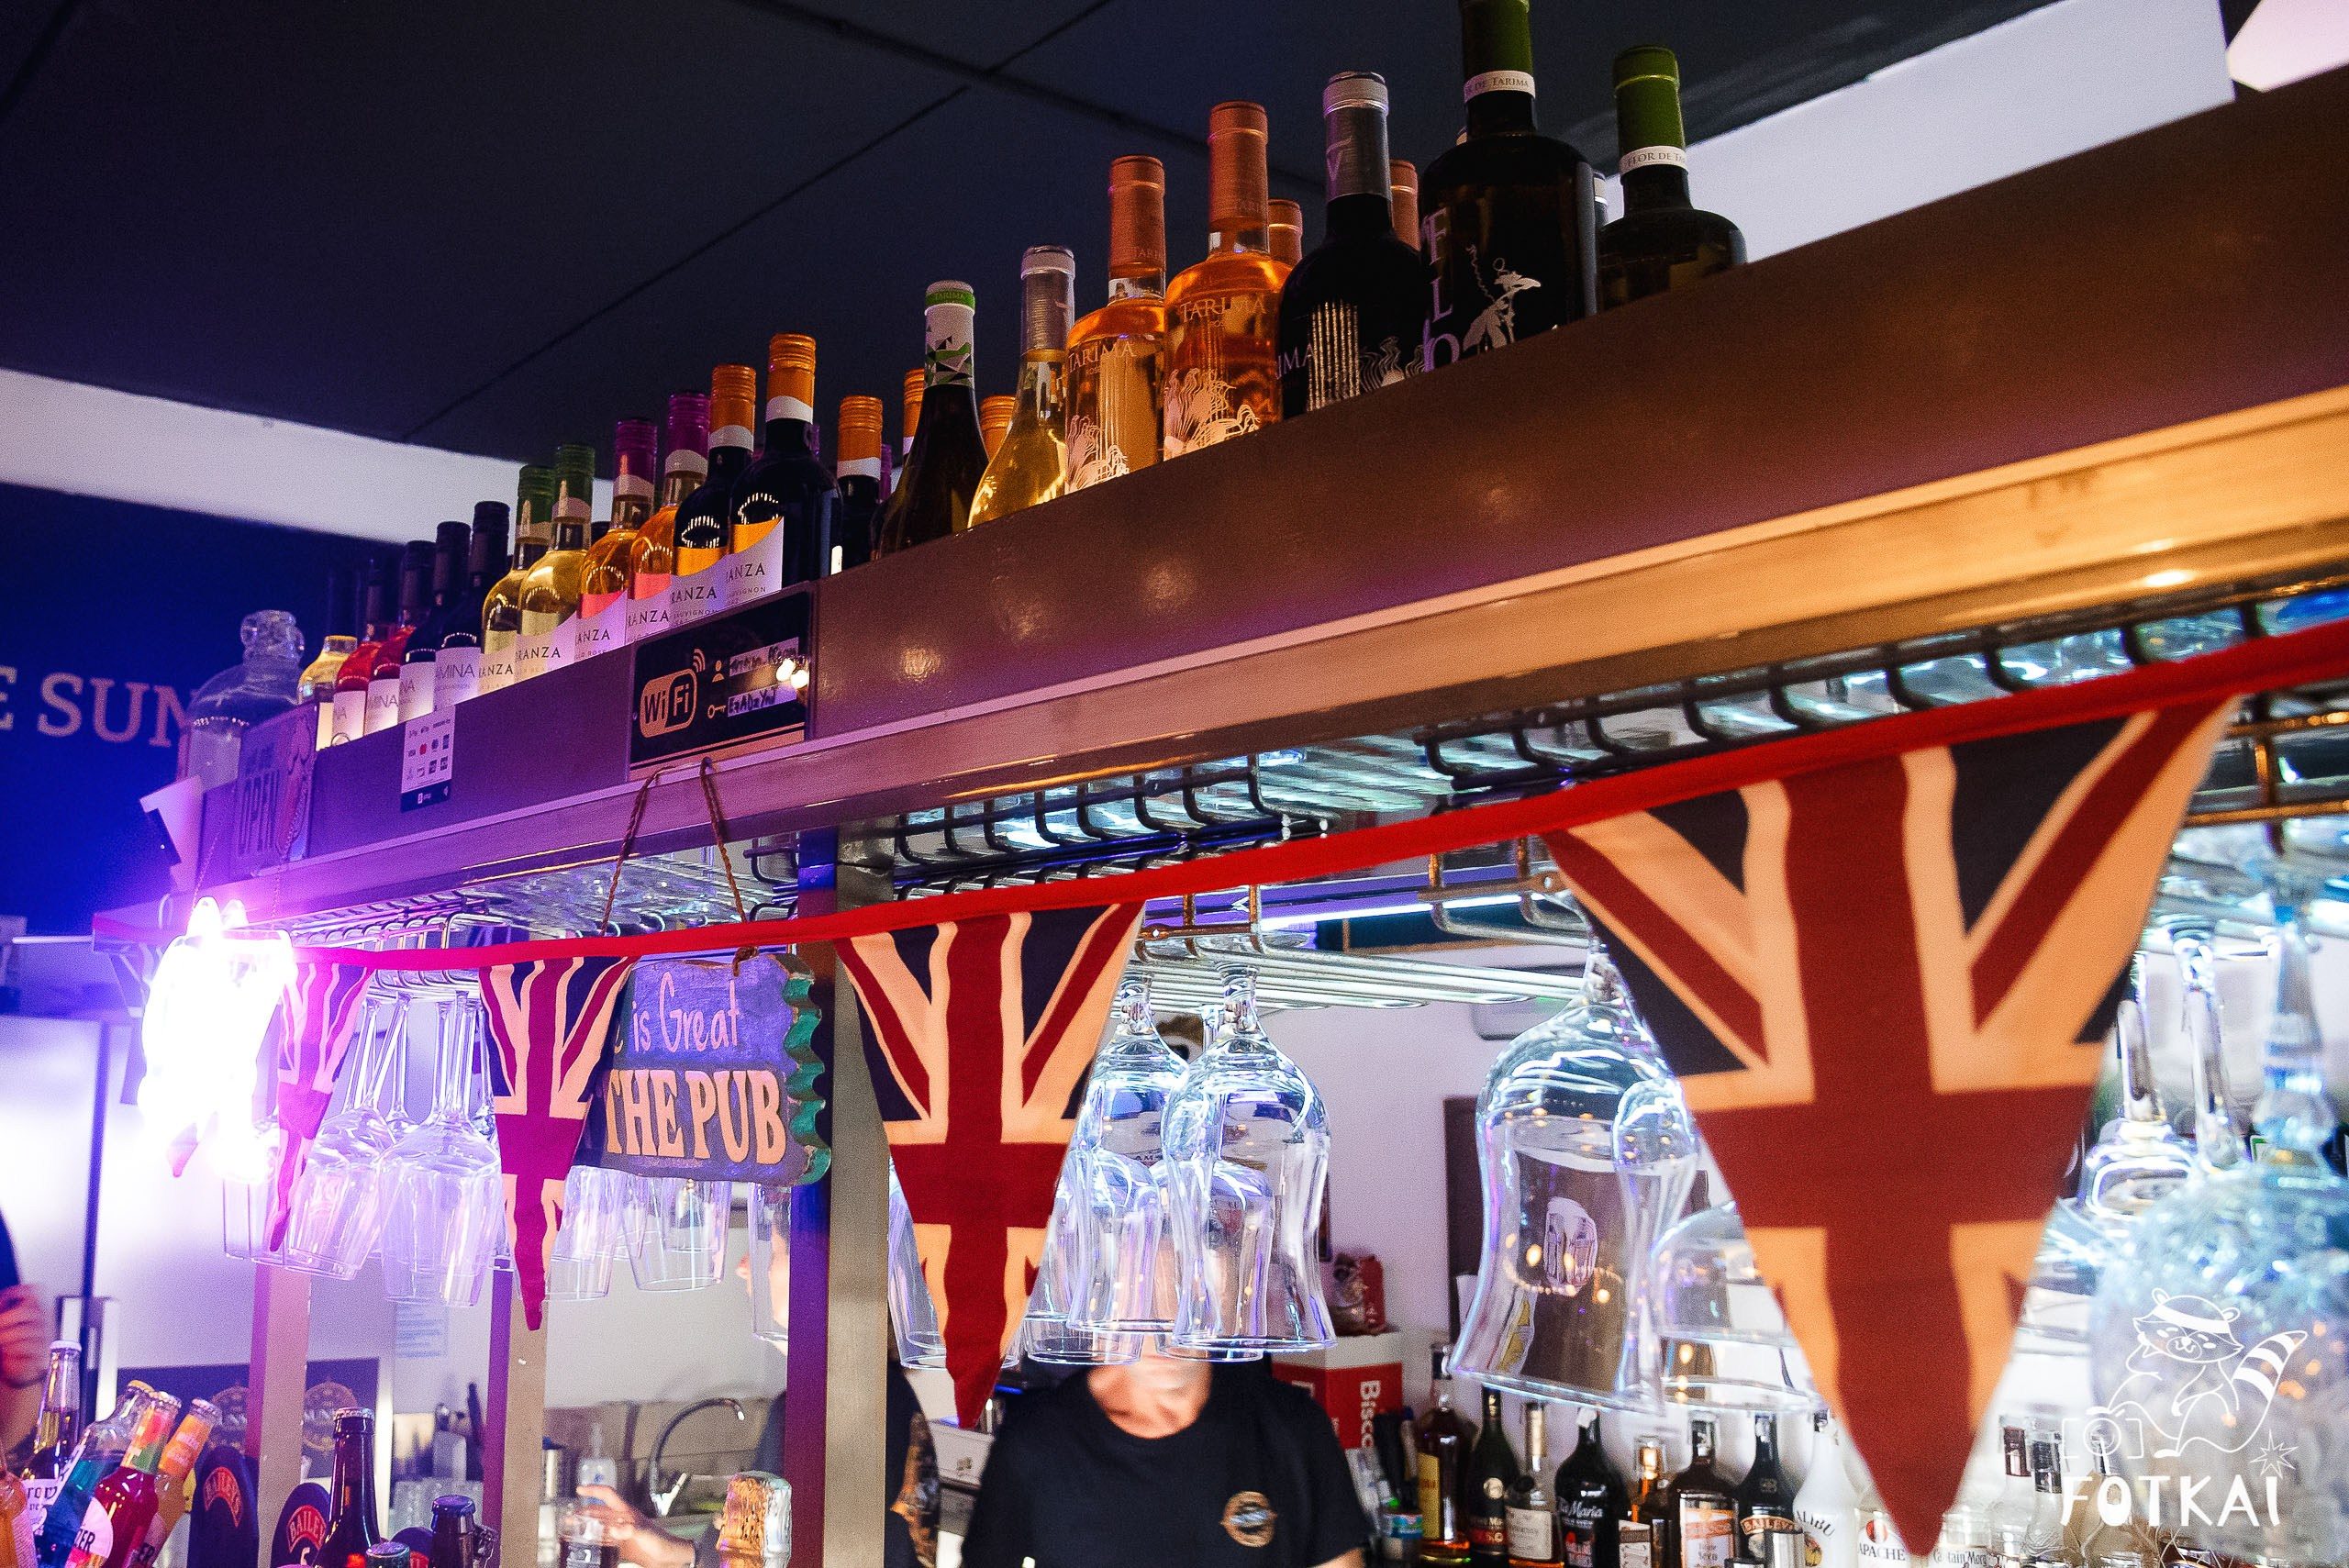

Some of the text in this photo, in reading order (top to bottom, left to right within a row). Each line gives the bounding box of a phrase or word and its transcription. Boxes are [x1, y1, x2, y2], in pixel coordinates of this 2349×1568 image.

[1658, 152, 1672, 161] DE
[631, 1000, 651, 1052] is
[659, 971, 740, 1053] Great
[606, 1068, 787, 1165] THE PUB
